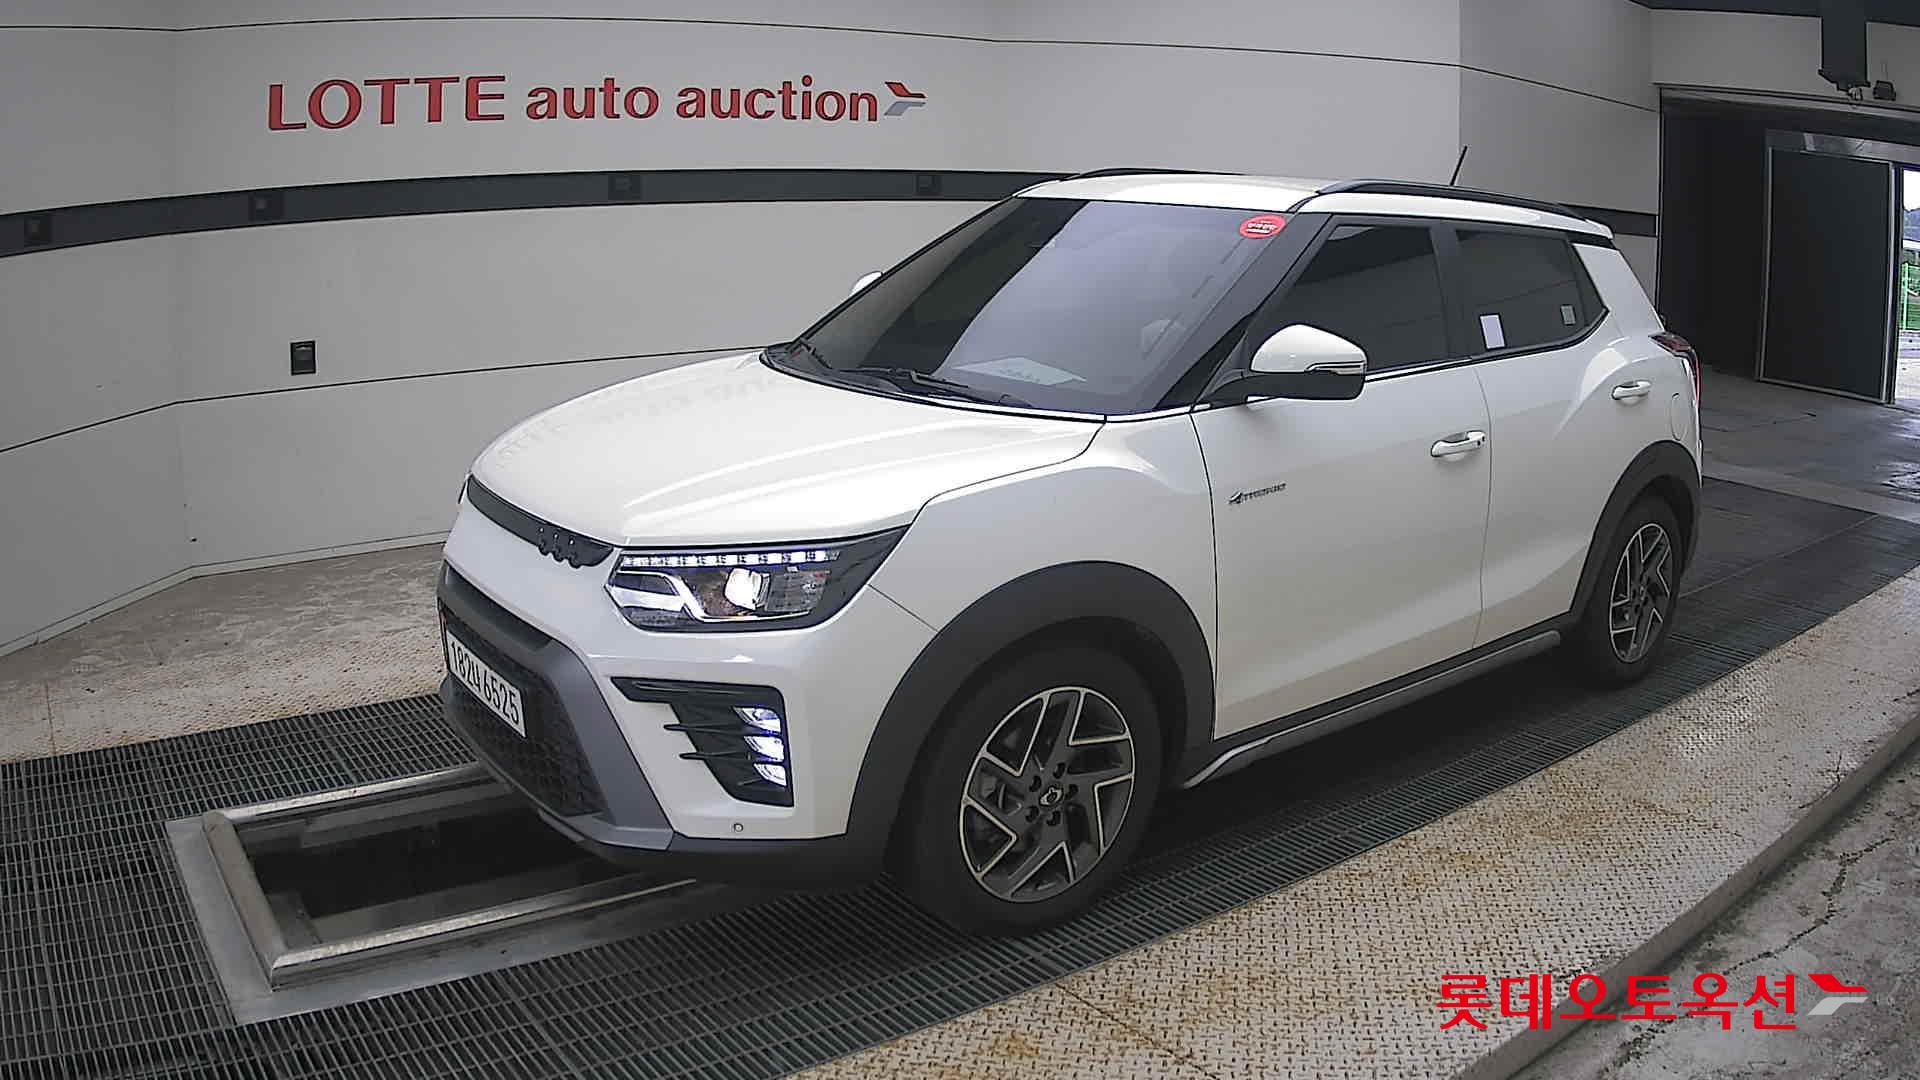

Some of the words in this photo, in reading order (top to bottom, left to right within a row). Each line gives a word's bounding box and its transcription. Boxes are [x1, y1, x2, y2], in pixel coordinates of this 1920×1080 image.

[268, 76, 506, 131] LOTTE
[525, 78, 660, 120] auto
[676, 76, 878, 122] auction
[484, 670, 519, 725] 6525
